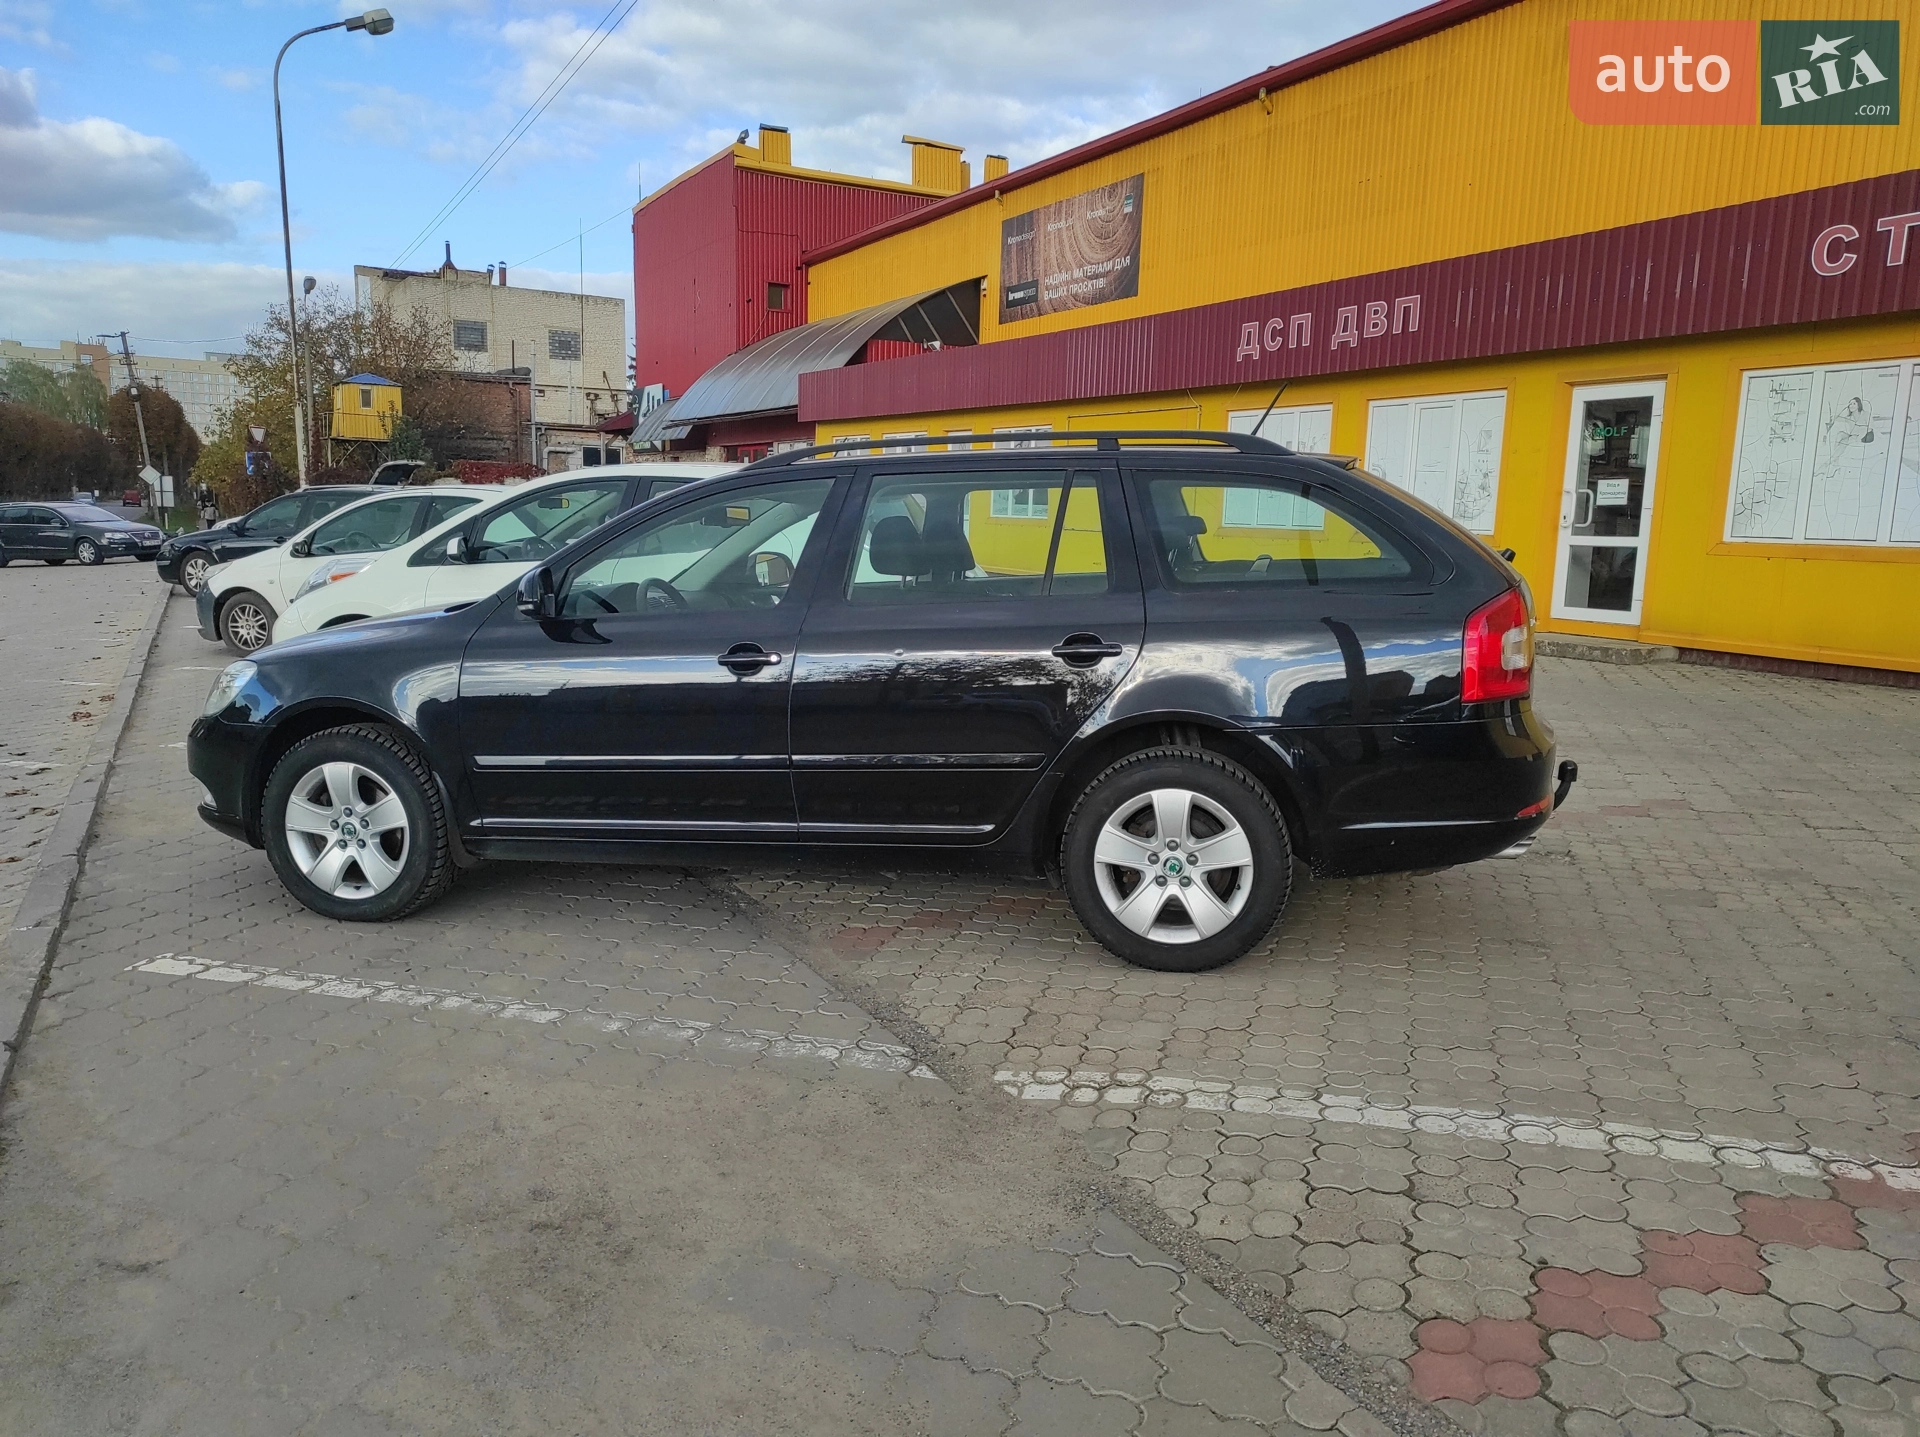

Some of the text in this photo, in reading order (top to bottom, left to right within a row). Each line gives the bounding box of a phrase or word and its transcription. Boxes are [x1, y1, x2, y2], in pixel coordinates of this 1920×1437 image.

[1044, 255, 1131, 286] НАДІЙНІ МАТЕРІАЛИ ДЛЯ
[1044, 278, 1106, 300] ВАШИХ ПРОЄКТІВ!
[1236, 295, 1421, 362] ДСП ДВП
